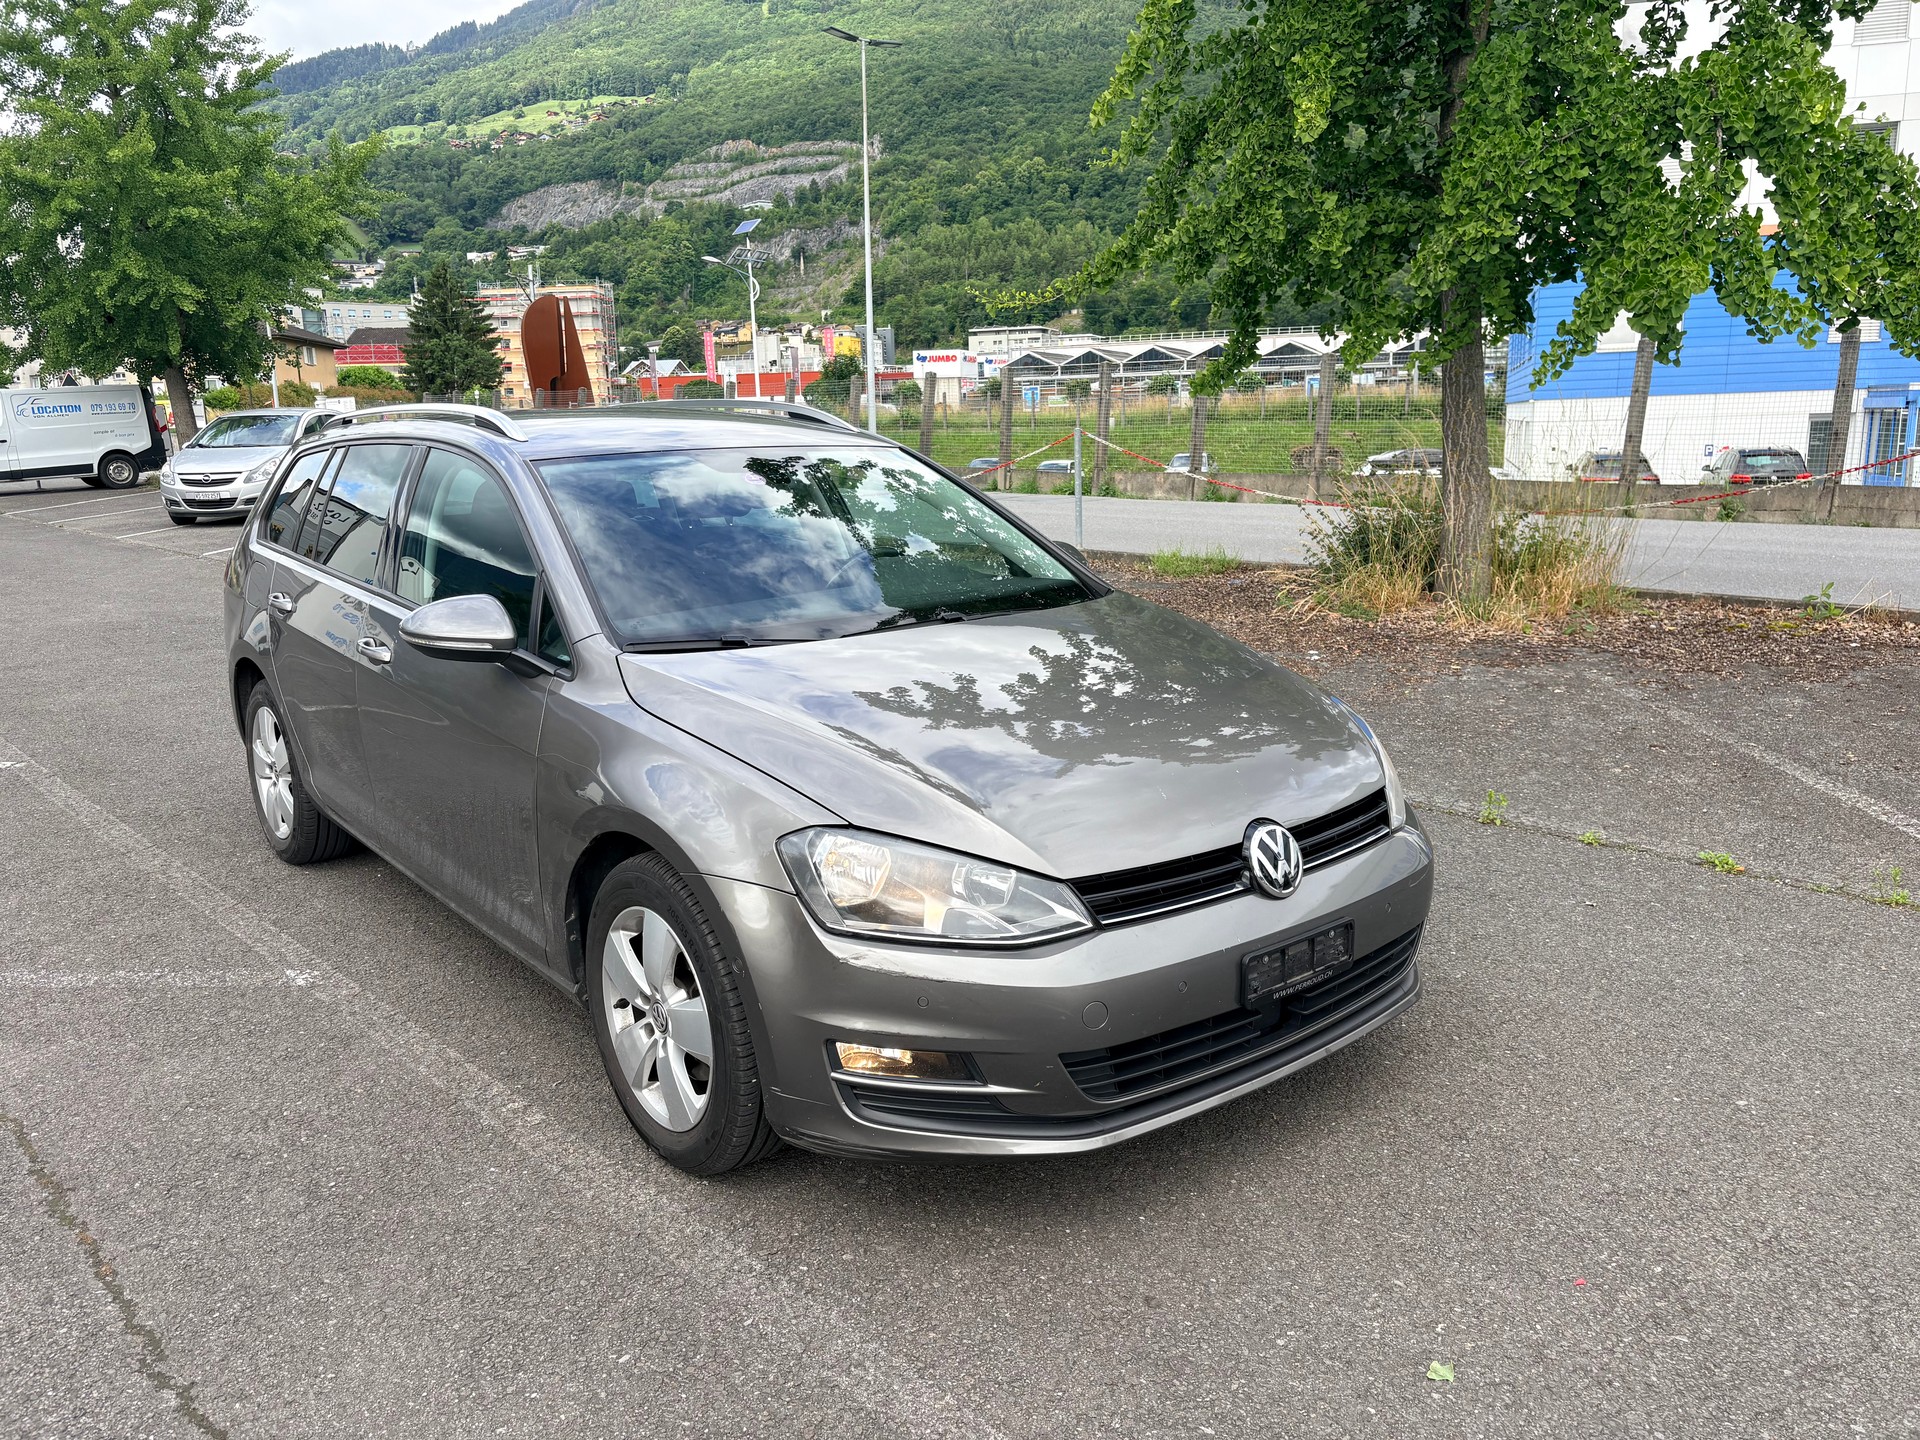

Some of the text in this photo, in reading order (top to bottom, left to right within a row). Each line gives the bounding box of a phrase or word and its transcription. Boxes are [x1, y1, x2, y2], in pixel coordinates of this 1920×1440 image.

[927, 354, 957, 363] JUMBO
[31, 404, 82, 415] LOCATION
[91, 402, 136, 412] 079 193 69 70
[667, 904, 689, 938] 205/55
[1273, 969, 1333, 999] WWW.PERROUD.CH
